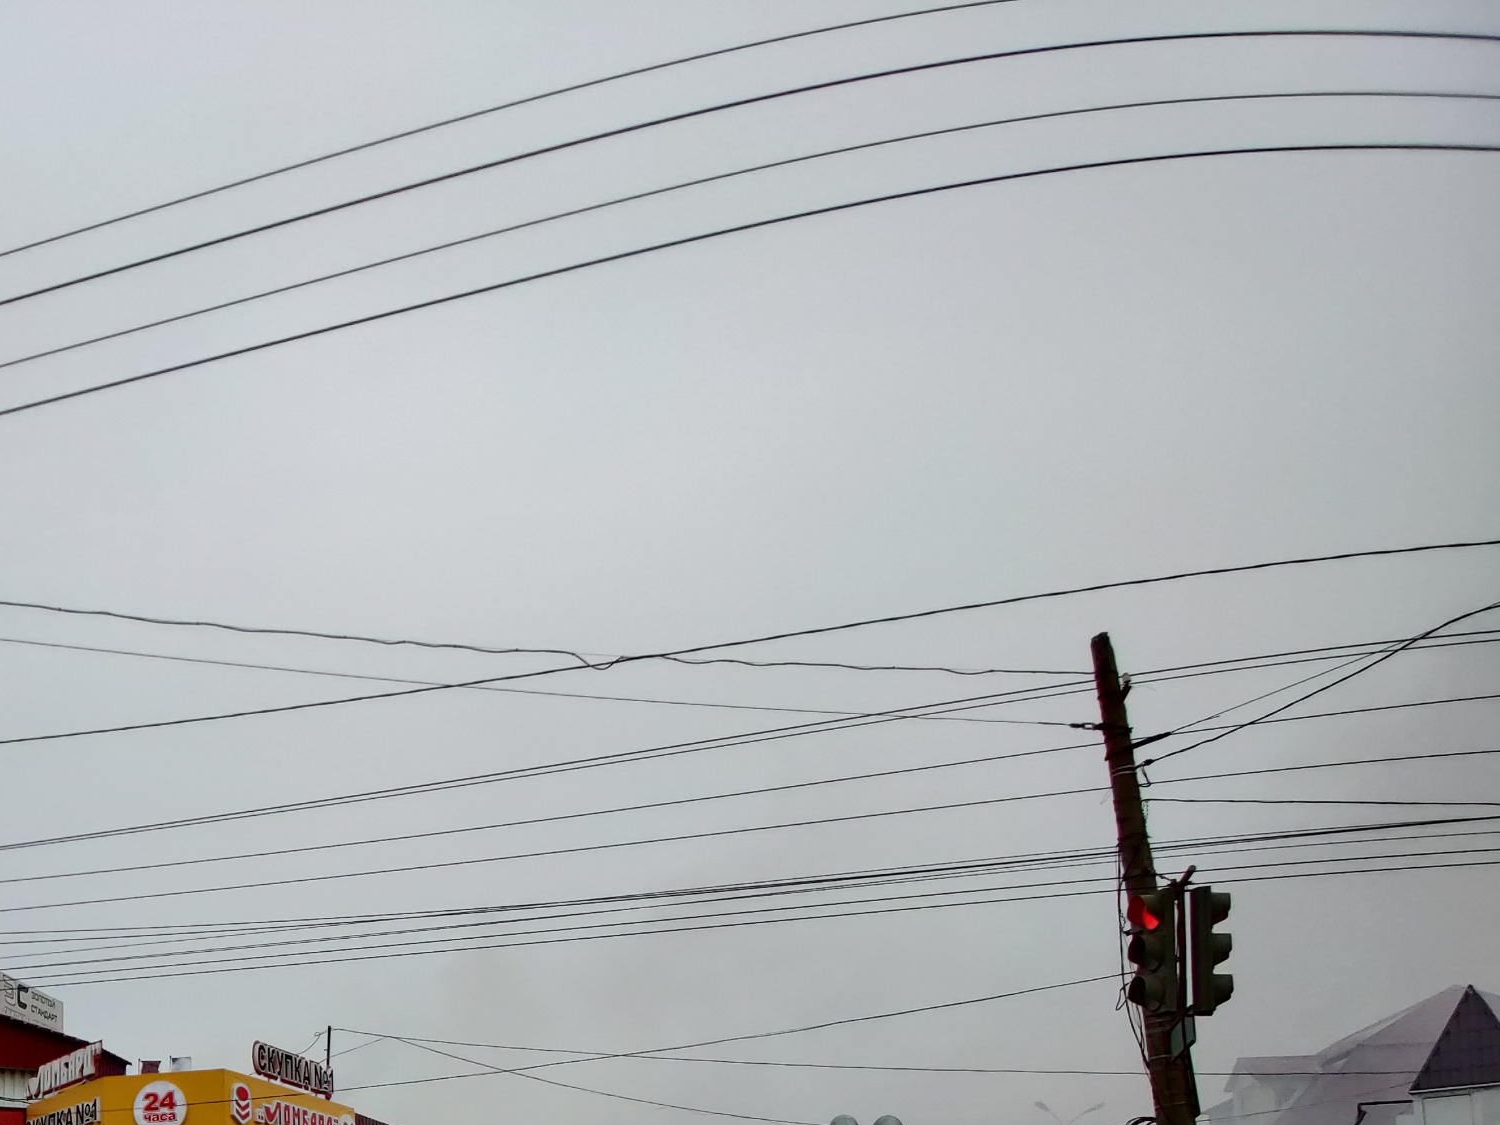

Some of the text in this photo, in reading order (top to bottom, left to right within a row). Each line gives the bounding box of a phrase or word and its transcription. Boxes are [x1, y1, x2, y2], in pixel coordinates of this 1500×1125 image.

[31, 991, 56, 1009] ЗОЛОТОЙ
[31, 1005, 57, 1023] СТАНДАРТ
[258, 1045, 334, 1093] СКУПКА №1
[76, 1098, 98, 1125] №1
[142, 1090, 176, 1113] 24
[143, 1112, 177, 1123] часа
